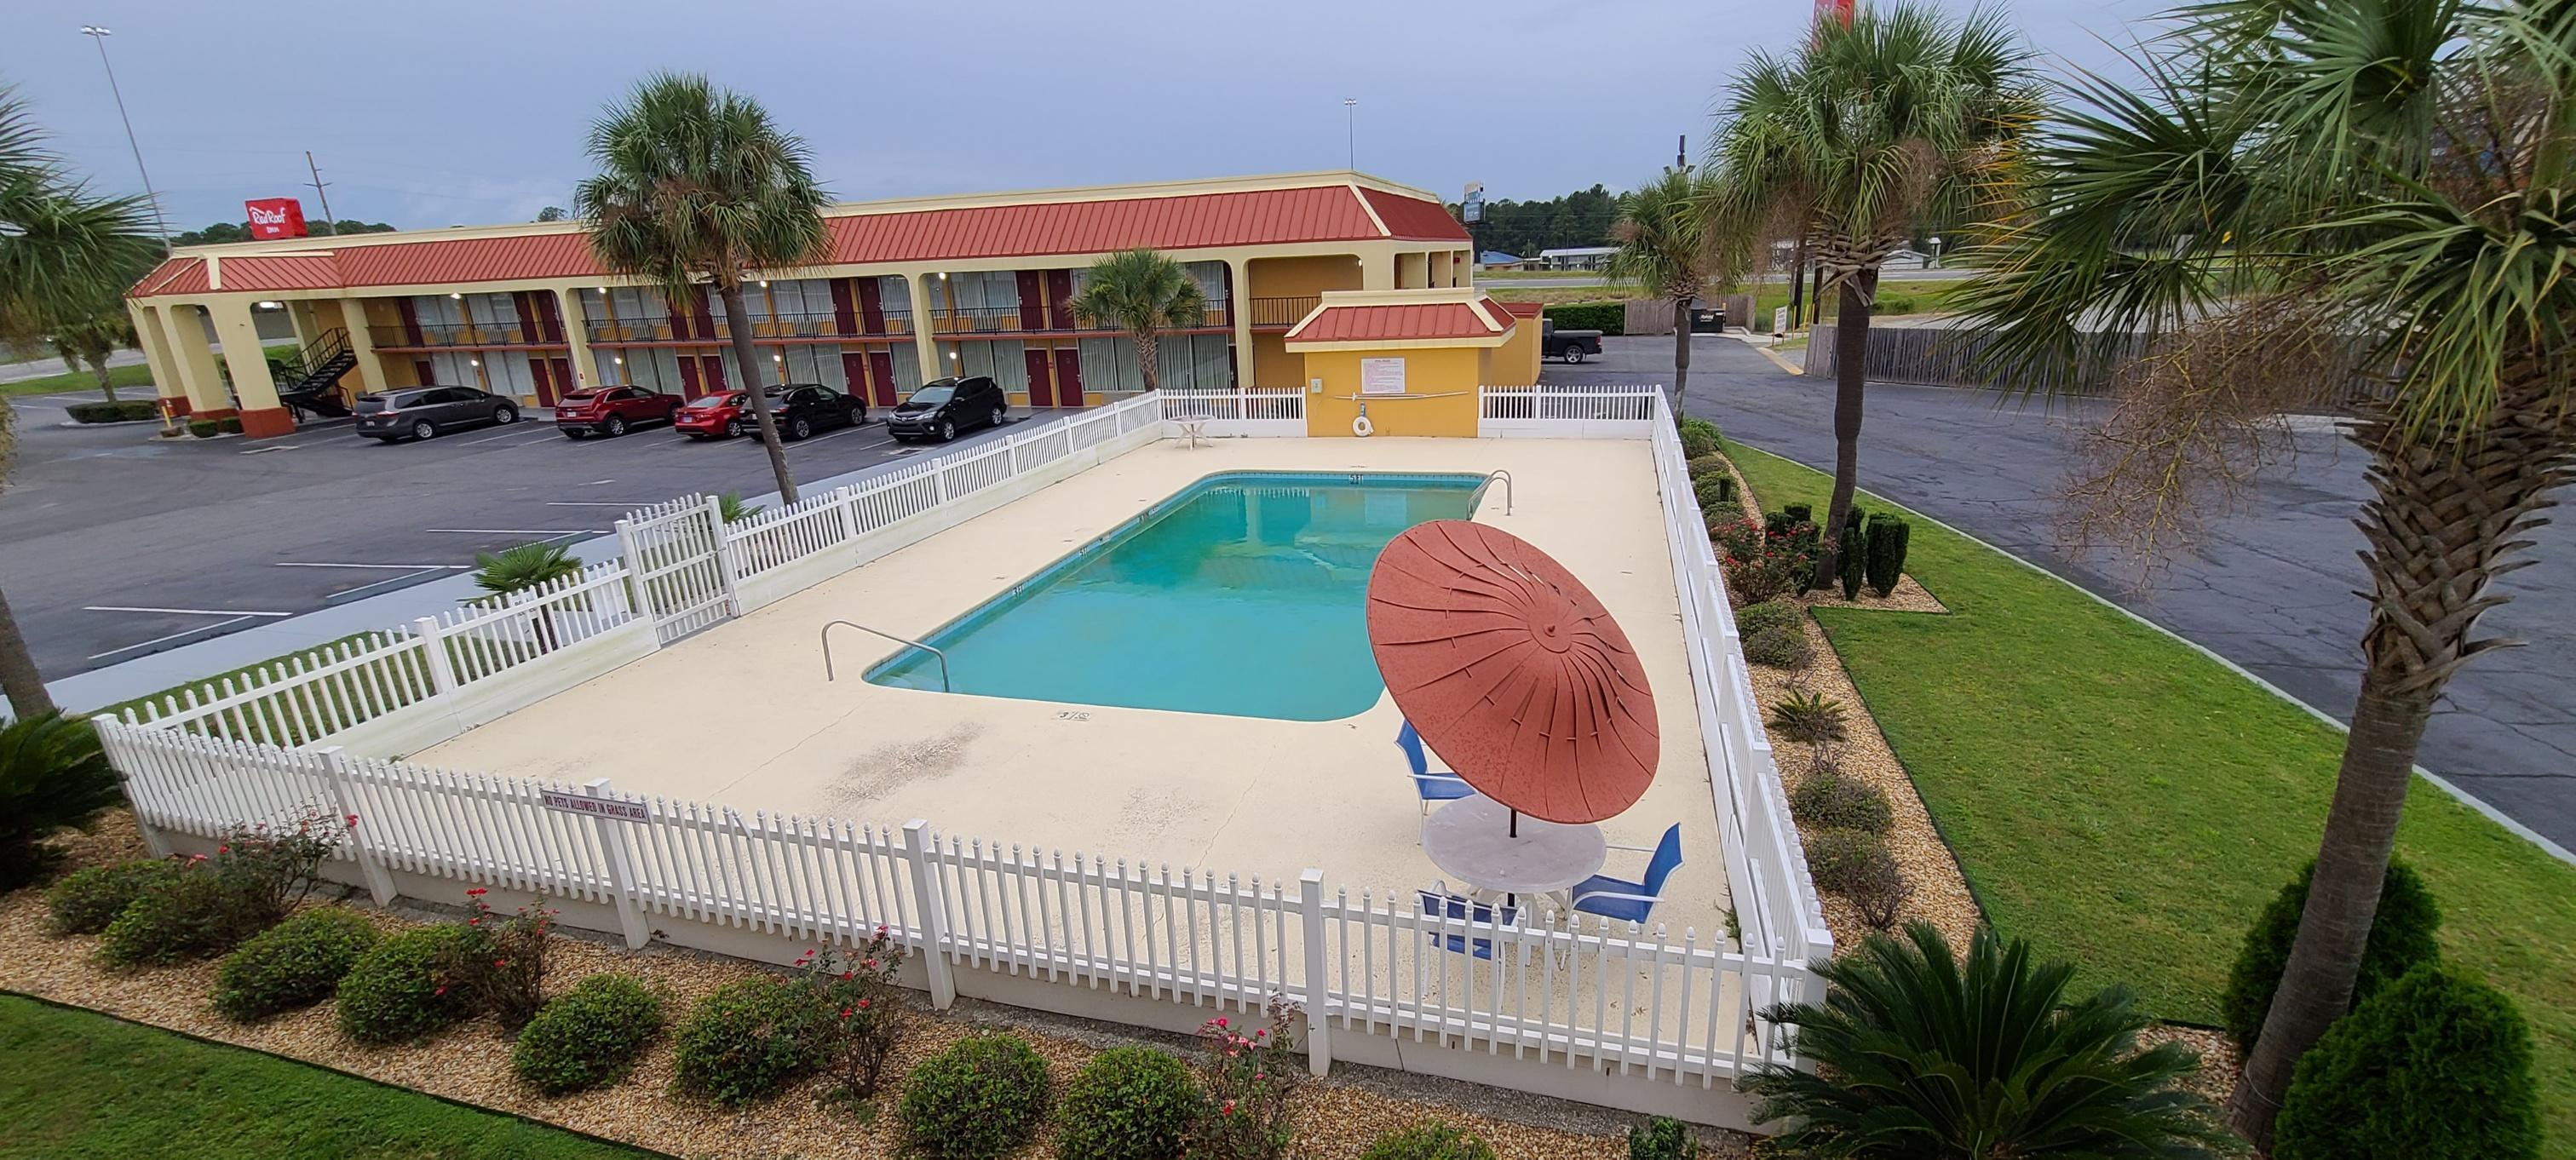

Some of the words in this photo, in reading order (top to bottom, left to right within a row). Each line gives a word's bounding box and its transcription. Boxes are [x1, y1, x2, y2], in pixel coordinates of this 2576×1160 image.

[252, 210, 269, 225] Red
[266, 207, 285, 224] Roof
[544, 795, 554, 806] NO
[554, 796, 569, 808] PETS
[570, 799, 597, 813] ALLOWED
[599, 803, 606, 814] IN
[607, 804, 628, 817] GRASS
[630, 807, 646, 819] AREA
